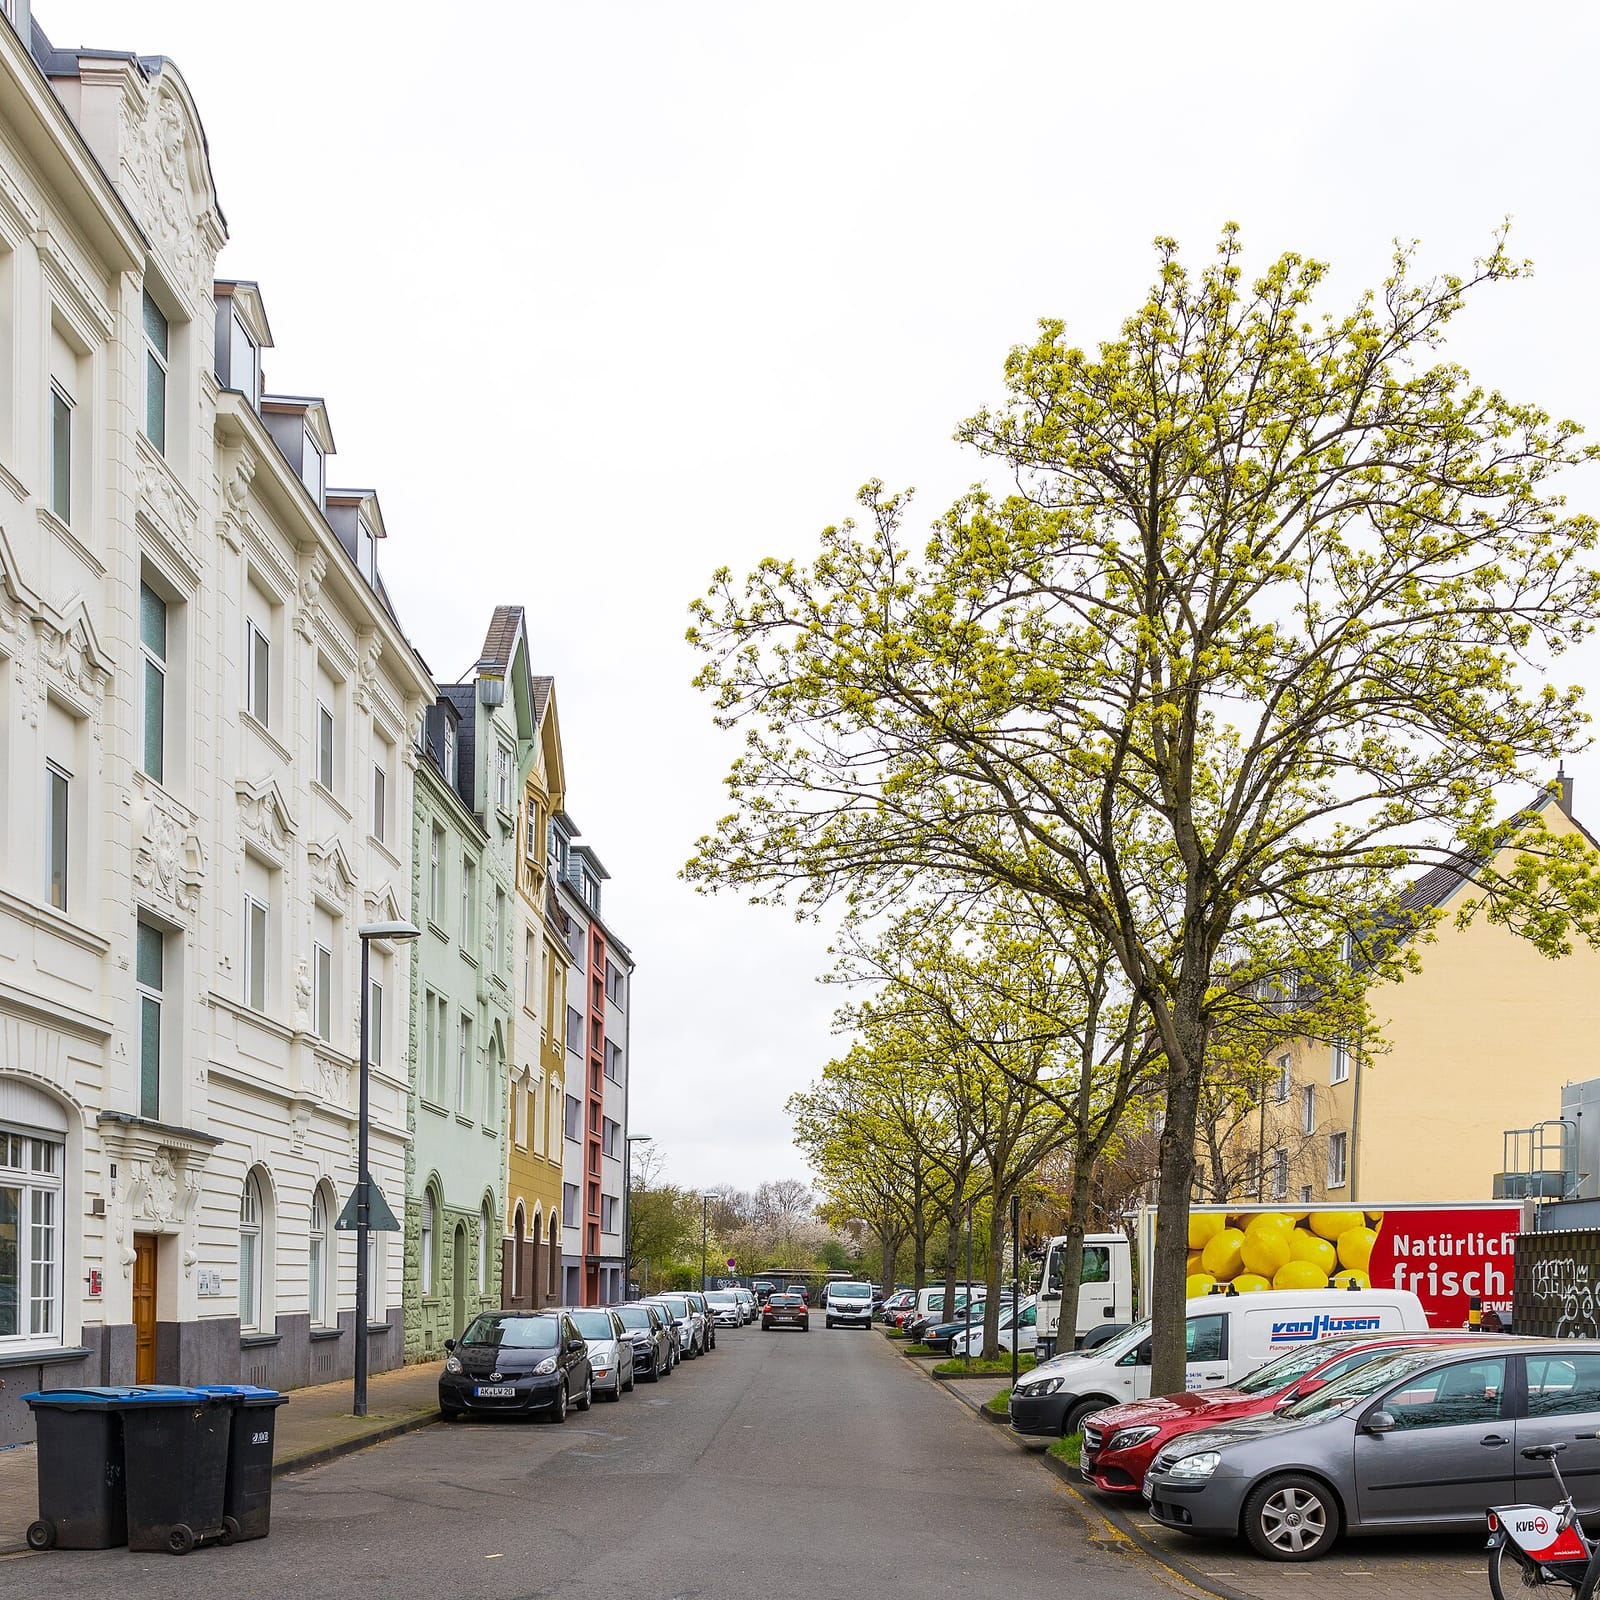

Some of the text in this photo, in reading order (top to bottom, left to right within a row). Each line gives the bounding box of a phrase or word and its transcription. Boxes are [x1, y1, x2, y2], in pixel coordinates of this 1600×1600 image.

[1393, 1232, 1514, 1257] Natürlich
[1480, 1301, 1513, 1313] EWE
[1516, 1521, 1535, 1532] KVB
